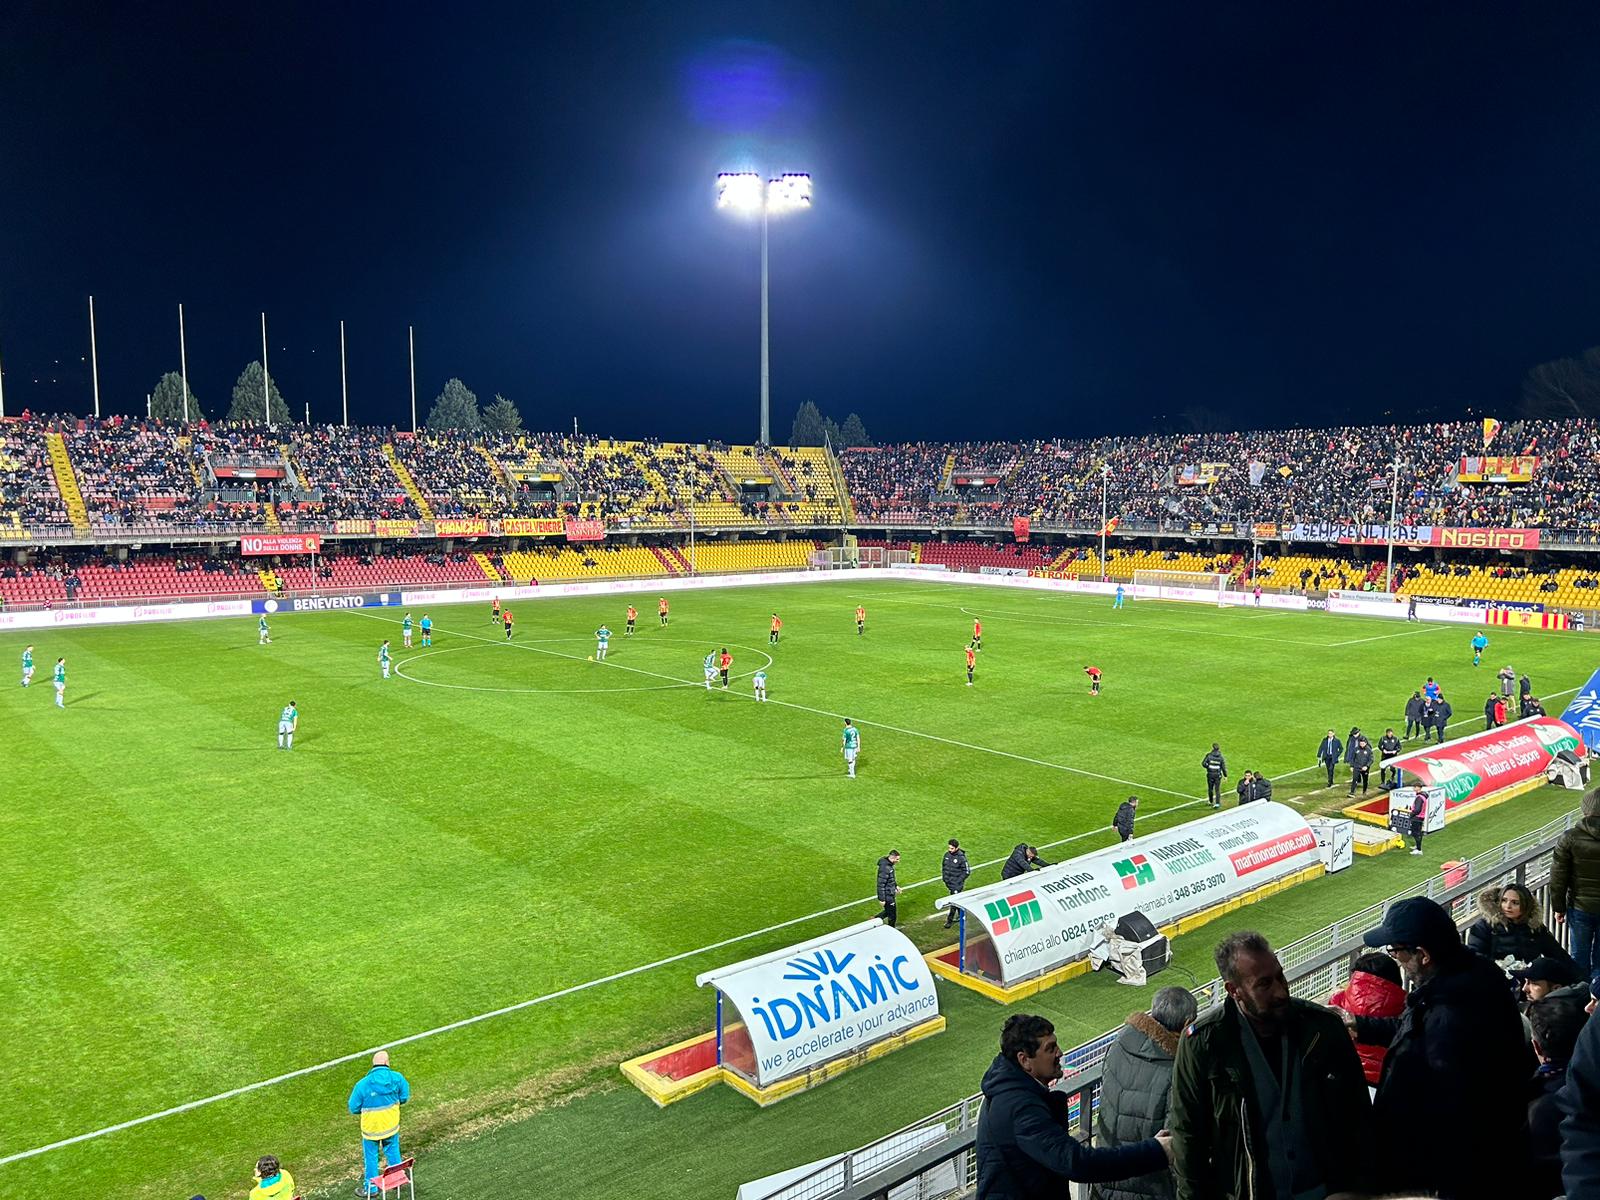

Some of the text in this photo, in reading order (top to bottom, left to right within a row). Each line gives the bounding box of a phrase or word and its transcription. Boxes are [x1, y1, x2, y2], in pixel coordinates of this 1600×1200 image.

[243, 539, 263, 552] NO
[1441, 528, 1525, 548] Nostro
[294, 596, 364, 610] BENEVENTO
[1483, 762, 1512, 777] Natura
[1513, 750, 1541, 766] Sapore
[1149, 837, 1205, 861] NARDONE
[1218, 831, 1260, 851] nuovo sito
[1233, 832, 1314, 871] martinonardone.com
[1164, 849, 1217, 875] HOTELLERIE
[1041, 871, 1095, 893] martino
[1173, 886, 1191, 900] 348
[1190, 881, 1207, 895] 365
[1206, 873, 1226, 889] 3970
[1057, 884, 1112, 911] nardone
[1004, 941, 1045, 964] chiamaci
[1045, 935, 1061, 949] allo
[1061, 923, 1088, 942] 0824
[762, 994, 936, 1072] we accelerate your advance
